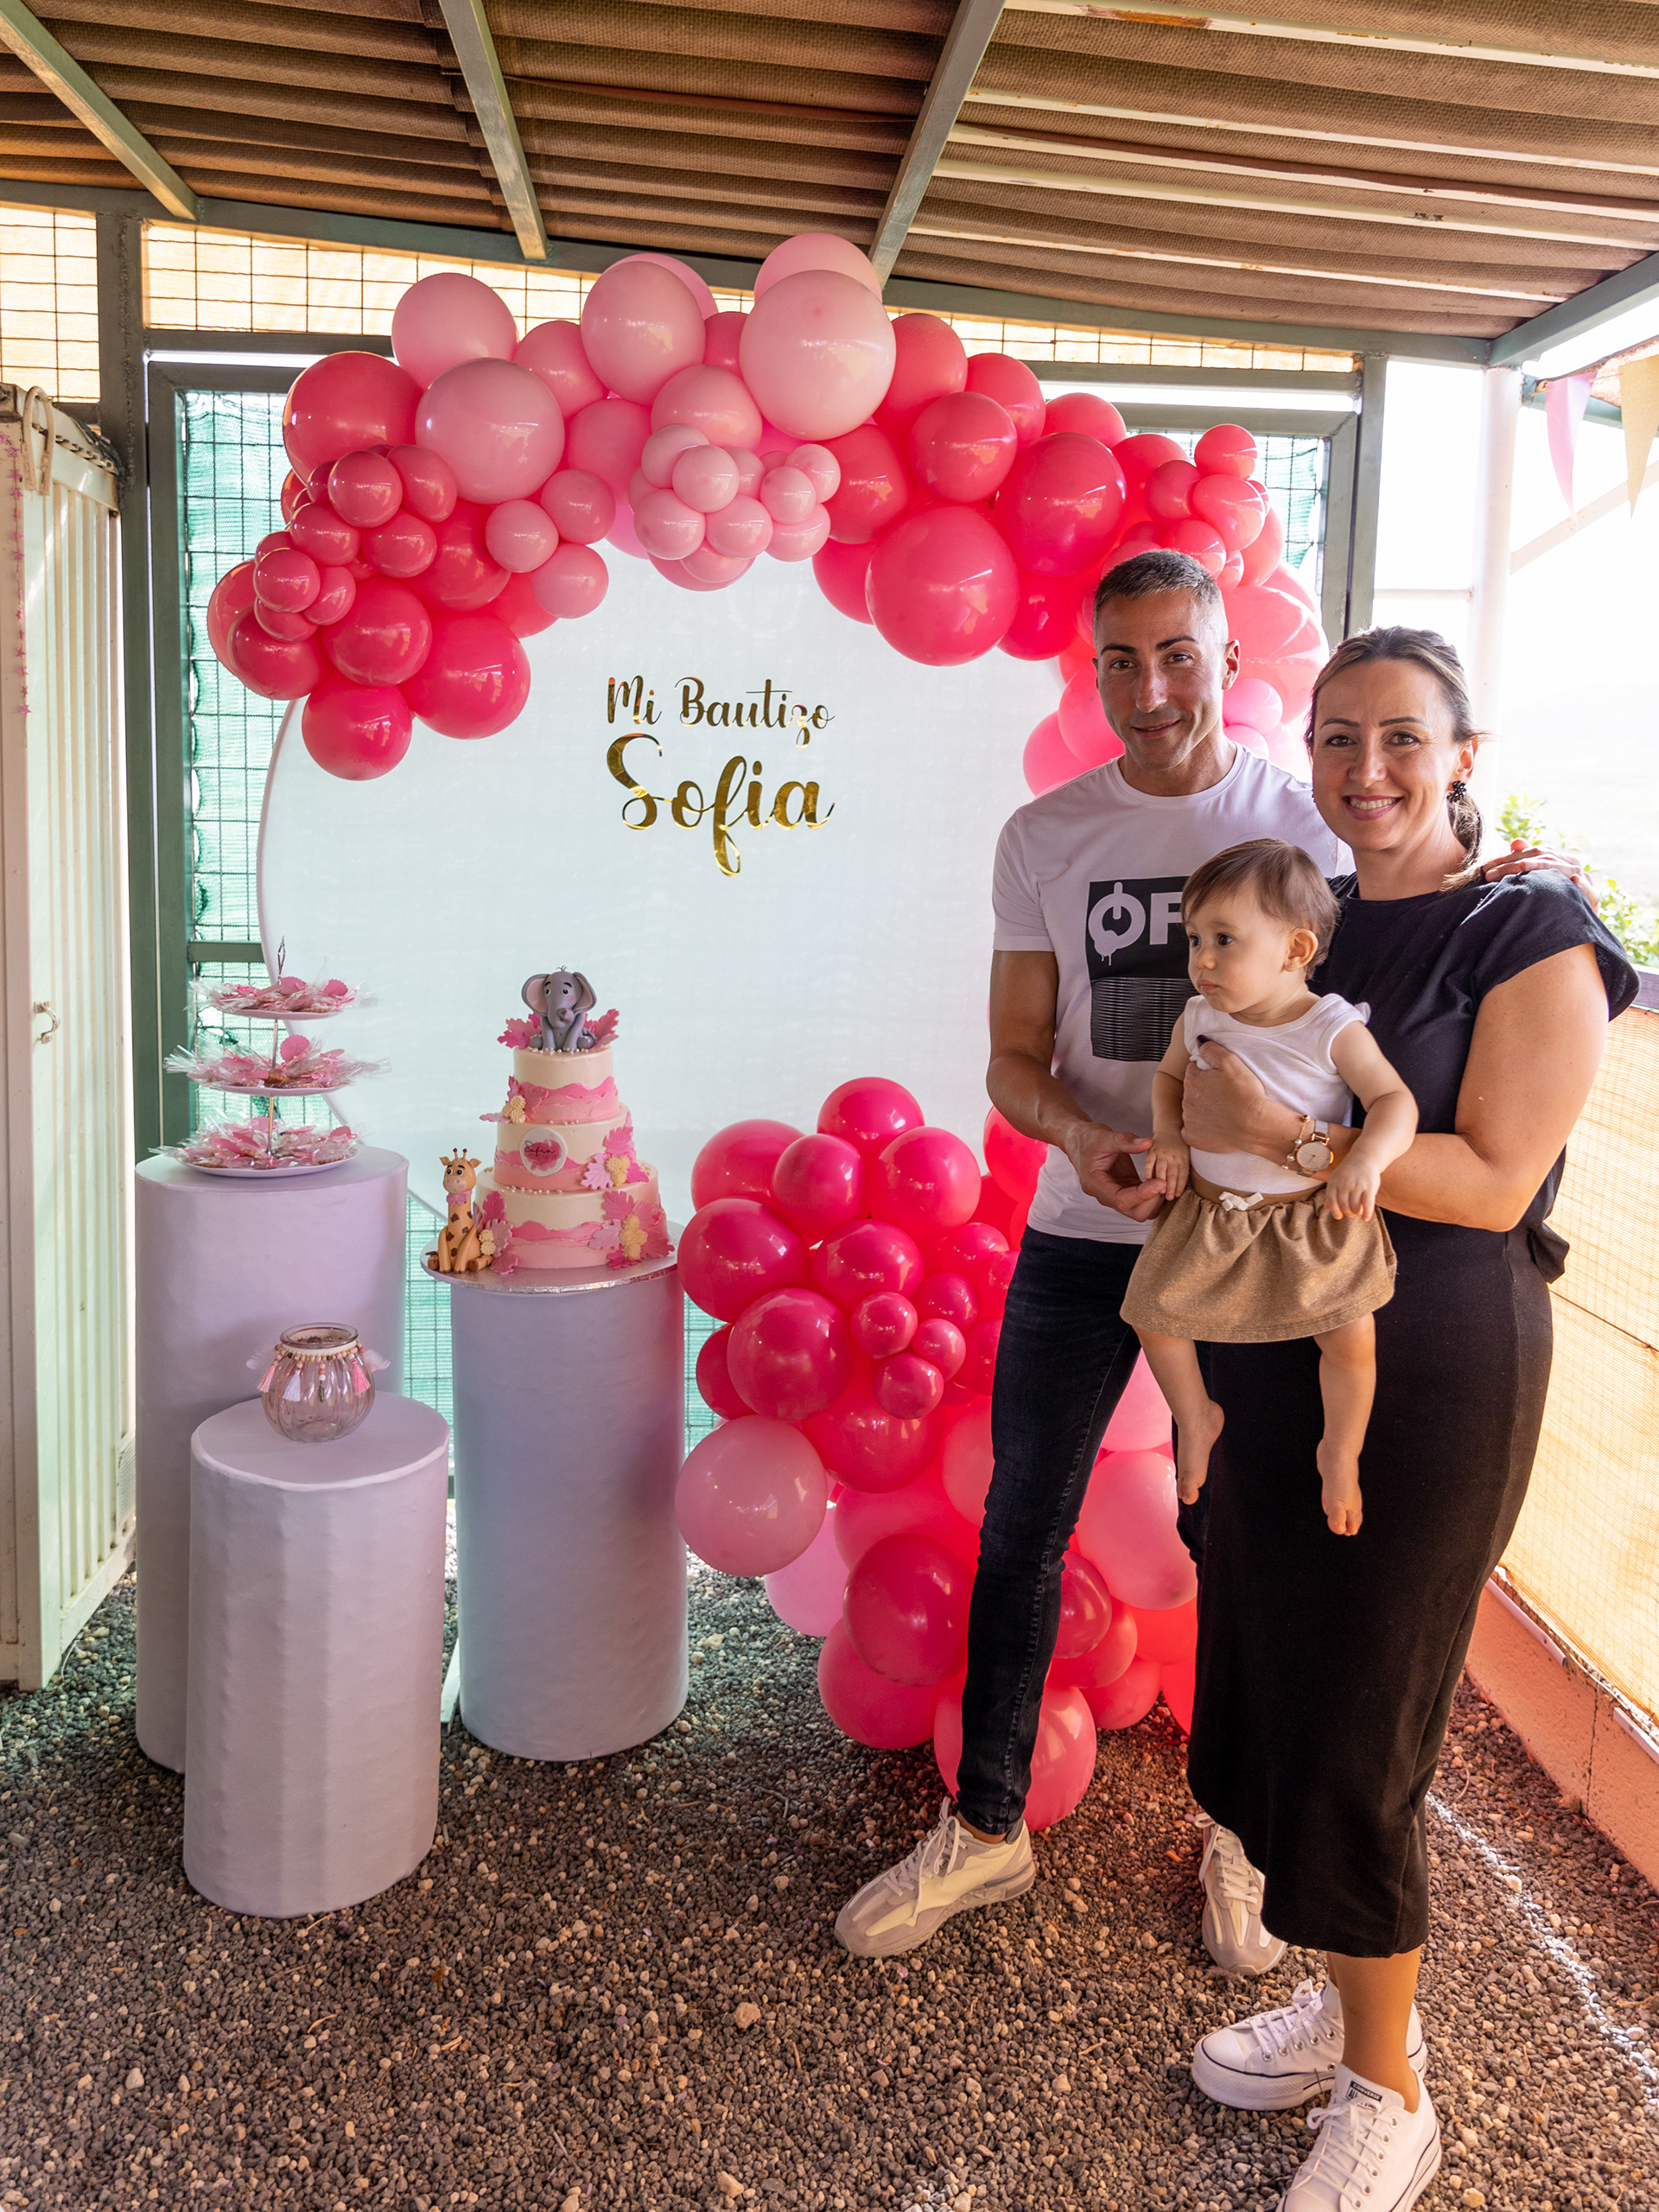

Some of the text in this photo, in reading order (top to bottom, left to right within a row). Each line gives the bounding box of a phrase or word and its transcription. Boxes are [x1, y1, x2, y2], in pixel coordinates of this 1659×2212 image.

[607, 676, 836, 750] Mi Bautizo
[607, 733, 836, 877] Sofia
[1352, 2082, 1381, 2101] CONVERSE
